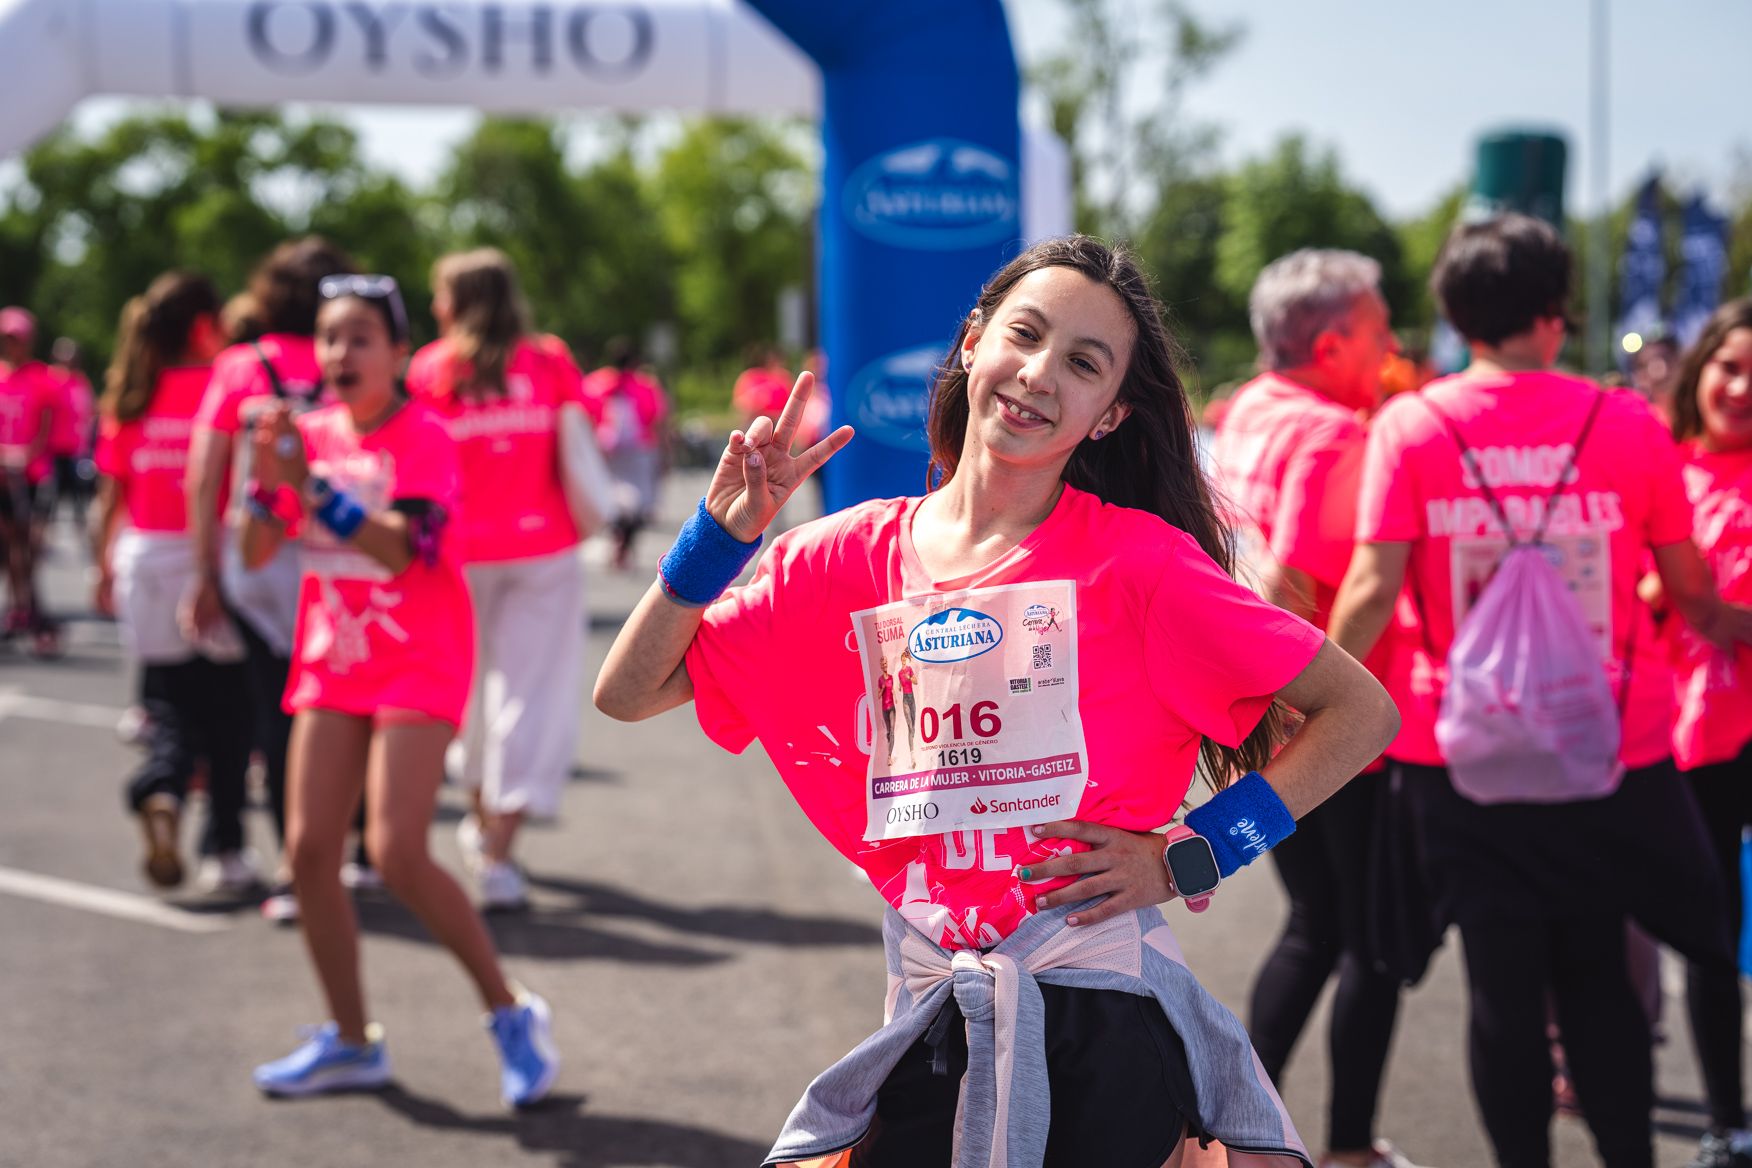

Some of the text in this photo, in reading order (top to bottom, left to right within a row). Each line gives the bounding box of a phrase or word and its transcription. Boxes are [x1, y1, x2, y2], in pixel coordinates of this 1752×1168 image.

[245, 0, 658, 82] OYSHO
[874, 617, 904, 630] TU DORSAL
[926, 622, 991, 635] CENTRAL LECHERA
[877, 626, 905, 644] SUMA
[914, 630, 995, 653] ASTURIANA
[920, 700, 1002, 743] 016
[938, 748, 982, 766] 1619
[875, 759, 1076, 795] CARRERA DE LA MUJER VITORIA-GASTEIZ
[886, 802, 939, 824] OYSHO
[990, 794, 1061, 814] Santander
